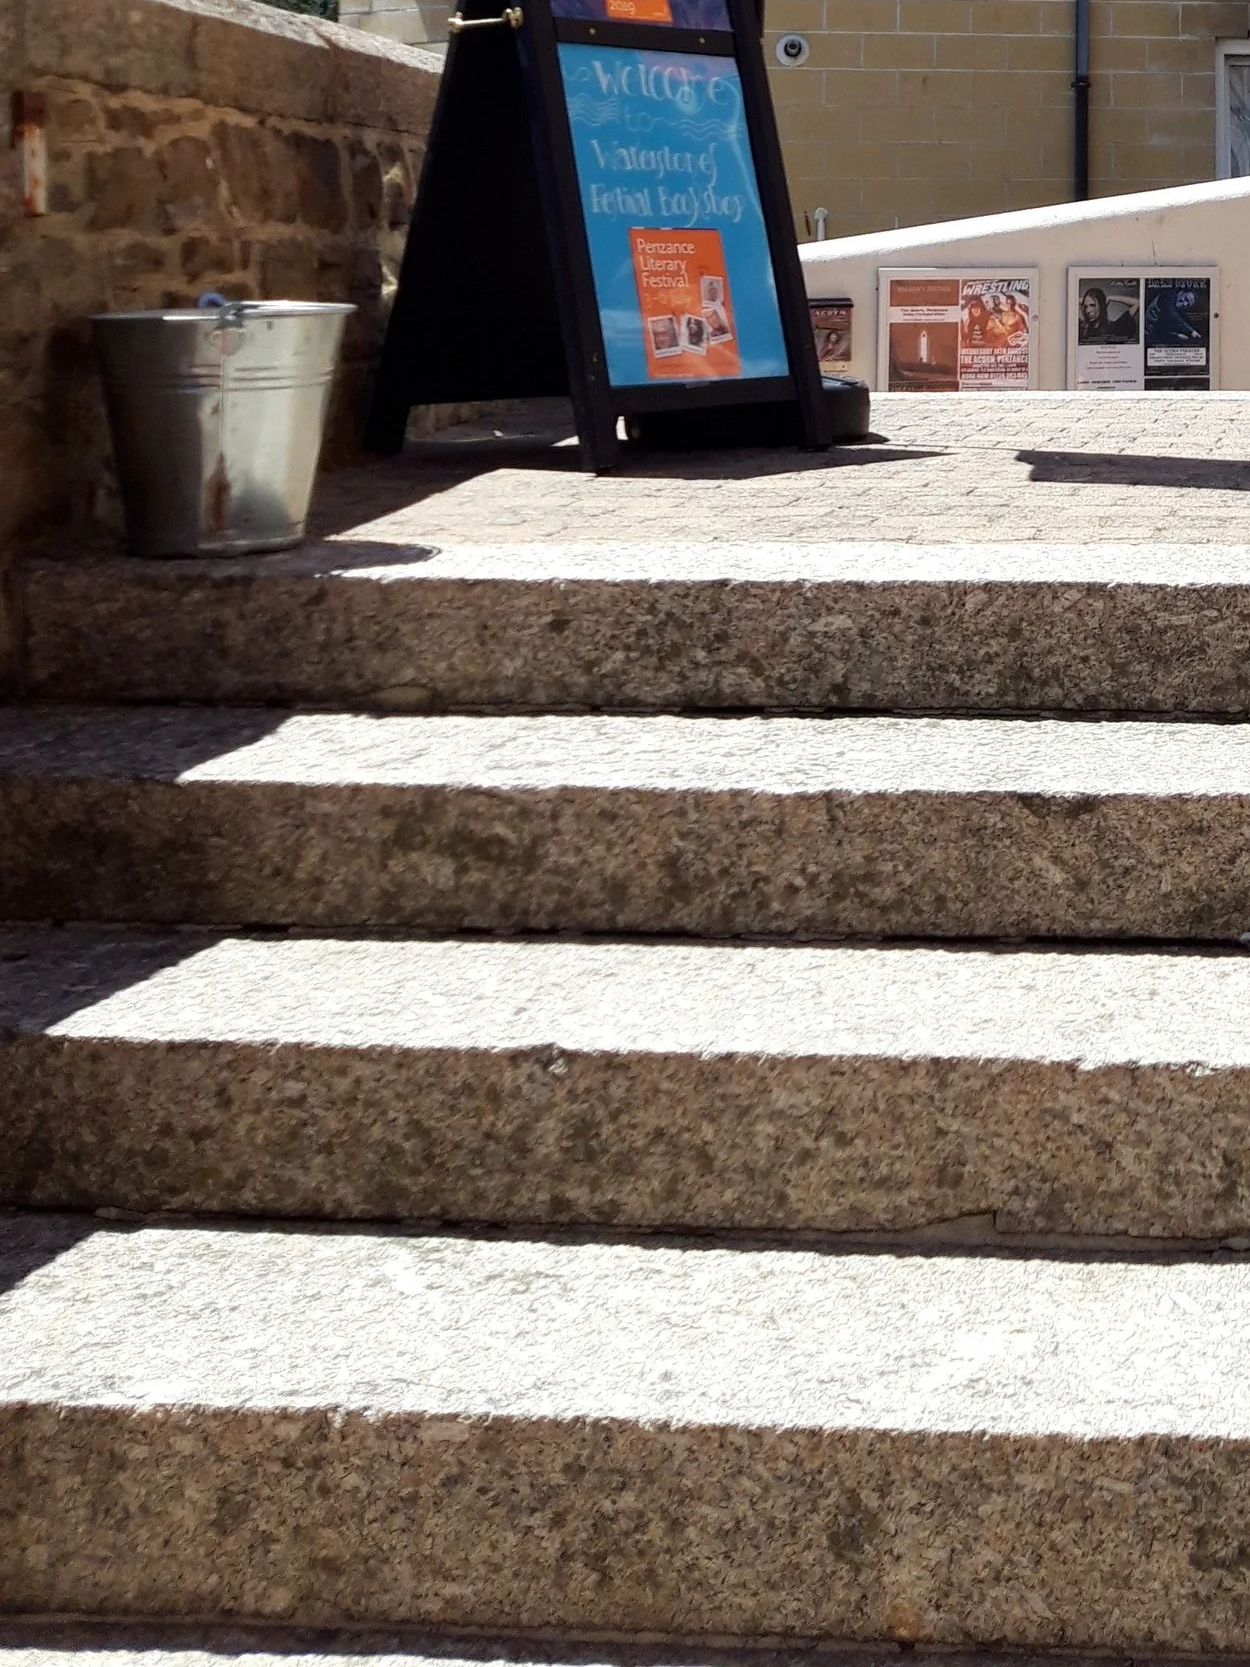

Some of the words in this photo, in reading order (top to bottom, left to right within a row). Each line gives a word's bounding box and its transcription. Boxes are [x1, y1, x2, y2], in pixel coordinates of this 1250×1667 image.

[608, 0, 637, 16] 2019
[624, 105, 654, 132] to
[636, 238, 696, 255] Penzance
[639, 254, 687, 274] Literary
[643, 271, 689, 288] Festival
[962, 279, 1029, 296] WRESTLING
[960, 355, 973, 364] THE
